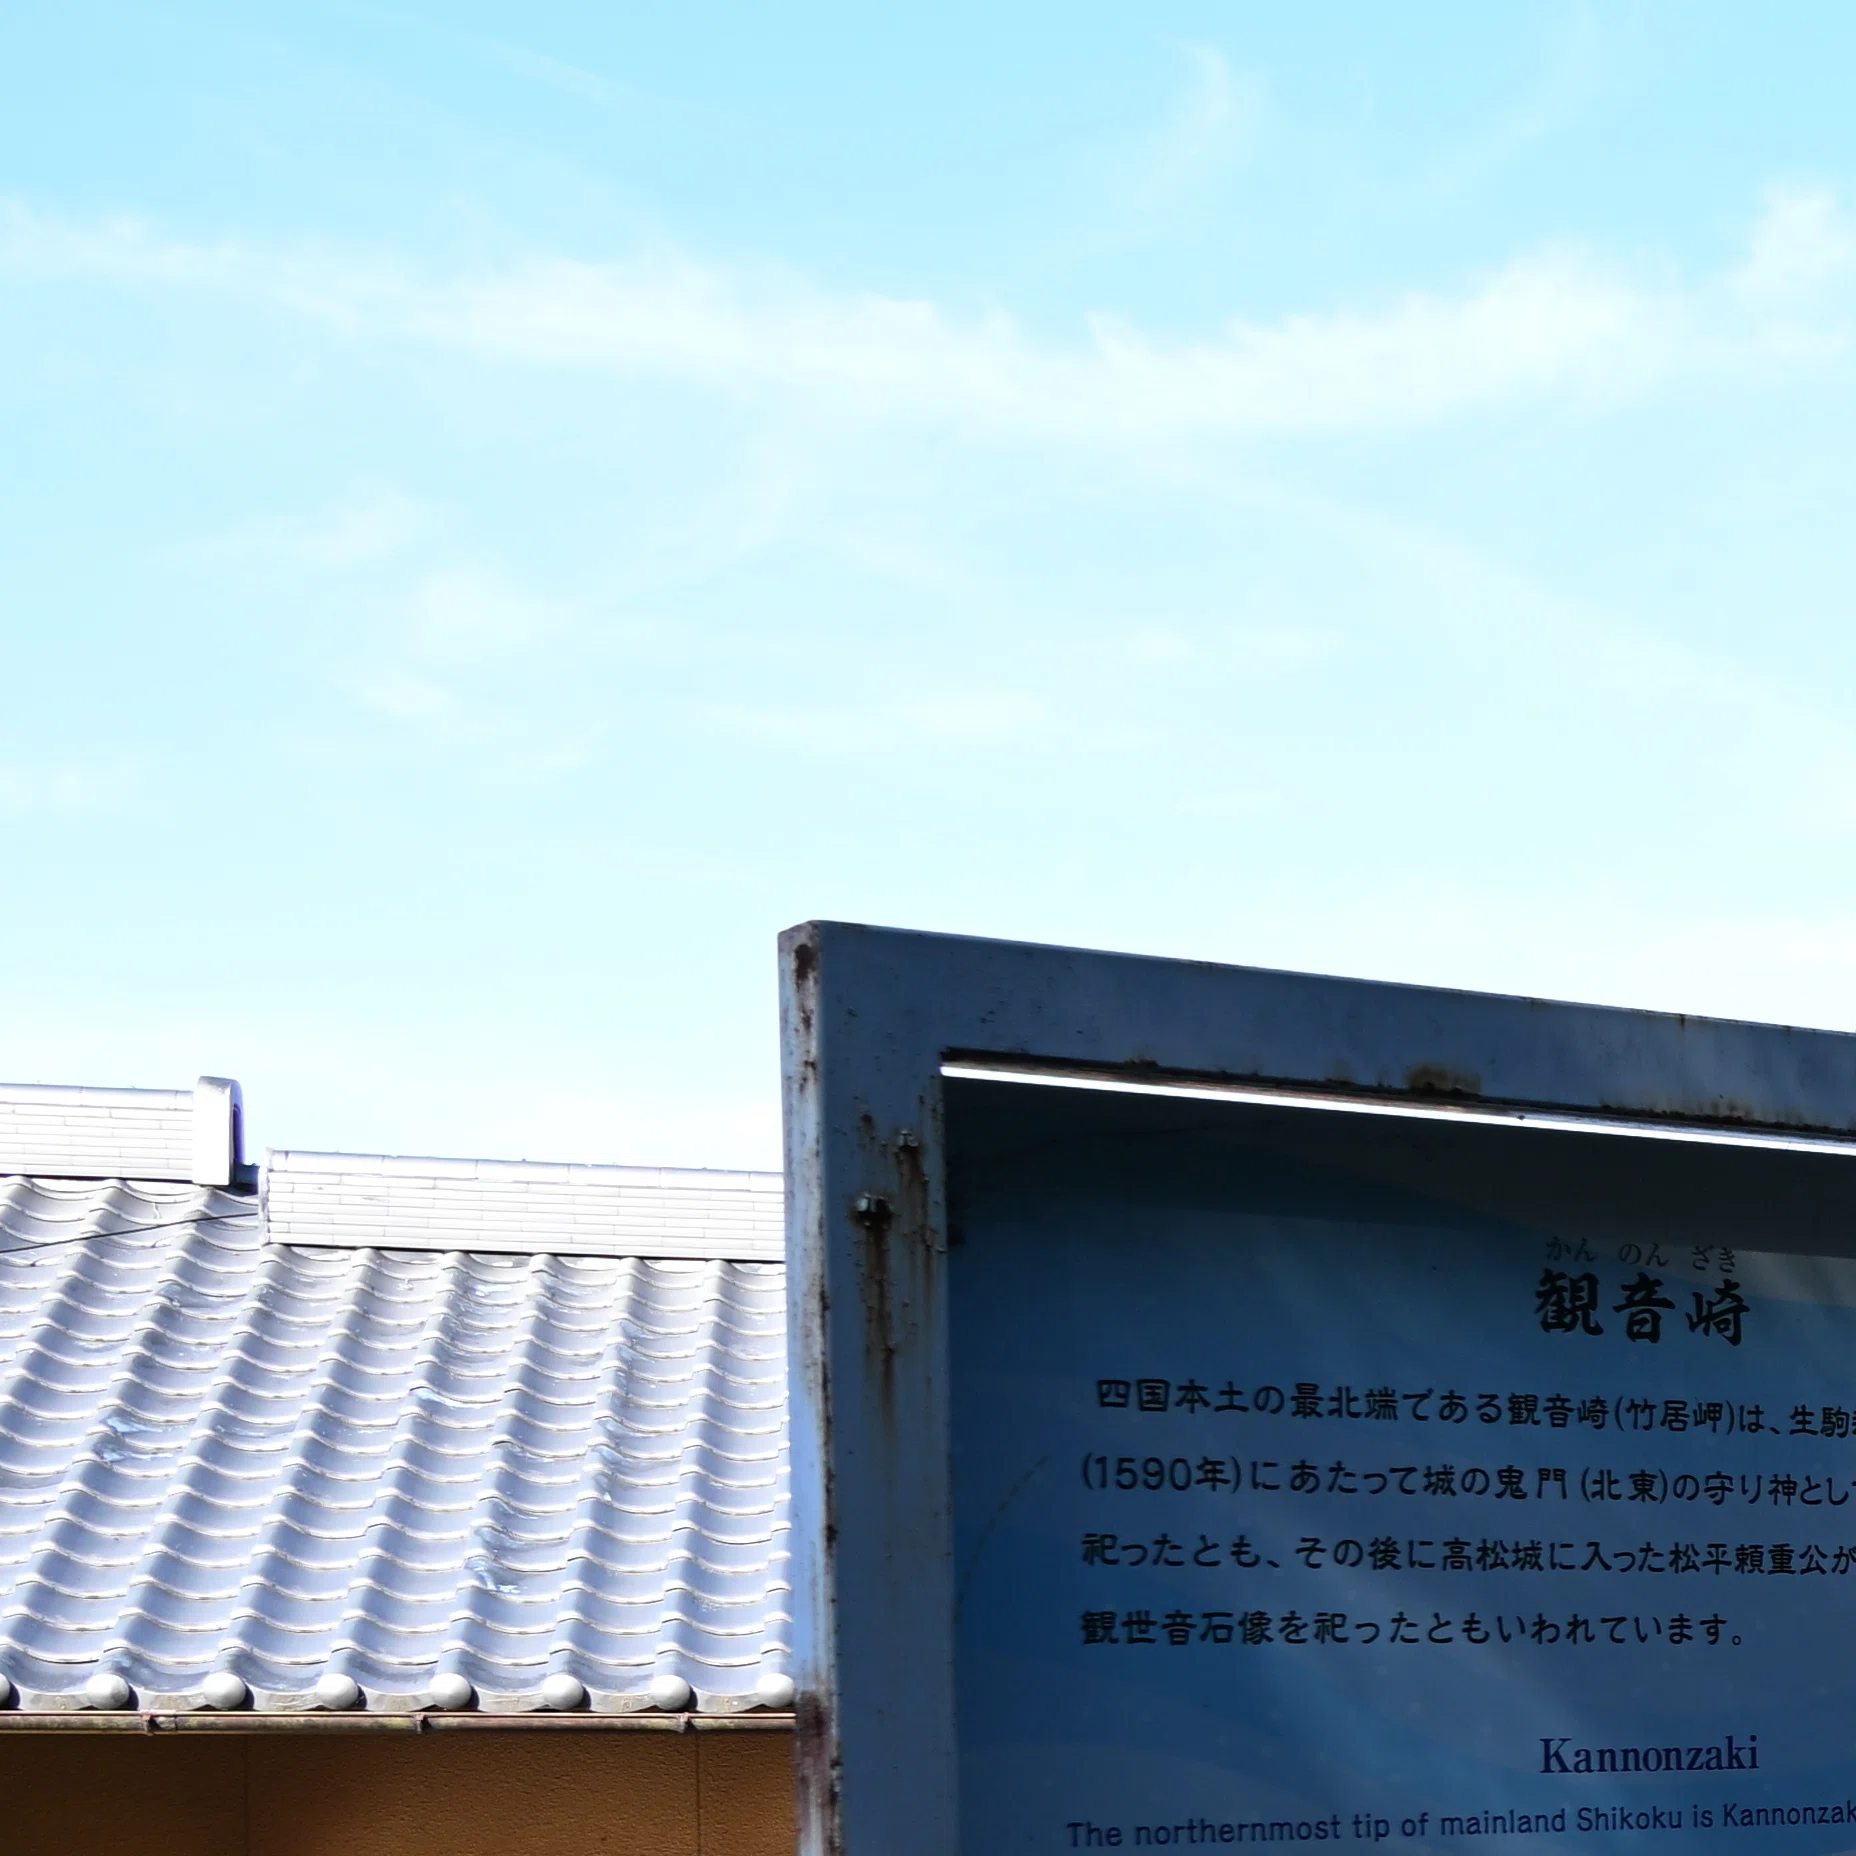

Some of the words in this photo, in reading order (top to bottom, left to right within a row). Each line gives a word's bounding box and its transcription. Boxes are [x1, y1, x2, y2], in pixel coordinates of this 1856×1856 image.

[1545, 1235, 1597, 1263] かん
[1617, 1243, 1670, 1268] のん
[1691, 1244, 1736, 1274] ざき
[1533, 1267, 1751, 1347] 観音崎
[1079, 1608, 1742, 1647] 観世音石像を祀ったともいわれています。
[1538, 1734, 1761, 1774] Kannonzaki
[1065, 1820, 1124, 1848] The
[1134, 1813, 1342, 1846] northernmost
[1351, 1812, 1391, 1843] tip
[1400, 1811, 1430, 1838] of
[1439, 1807, 1566, 1836] mainland
[1576, 1805, 1683, 1832] Shikoku
[1692, 1803, 1714, 1829] is
